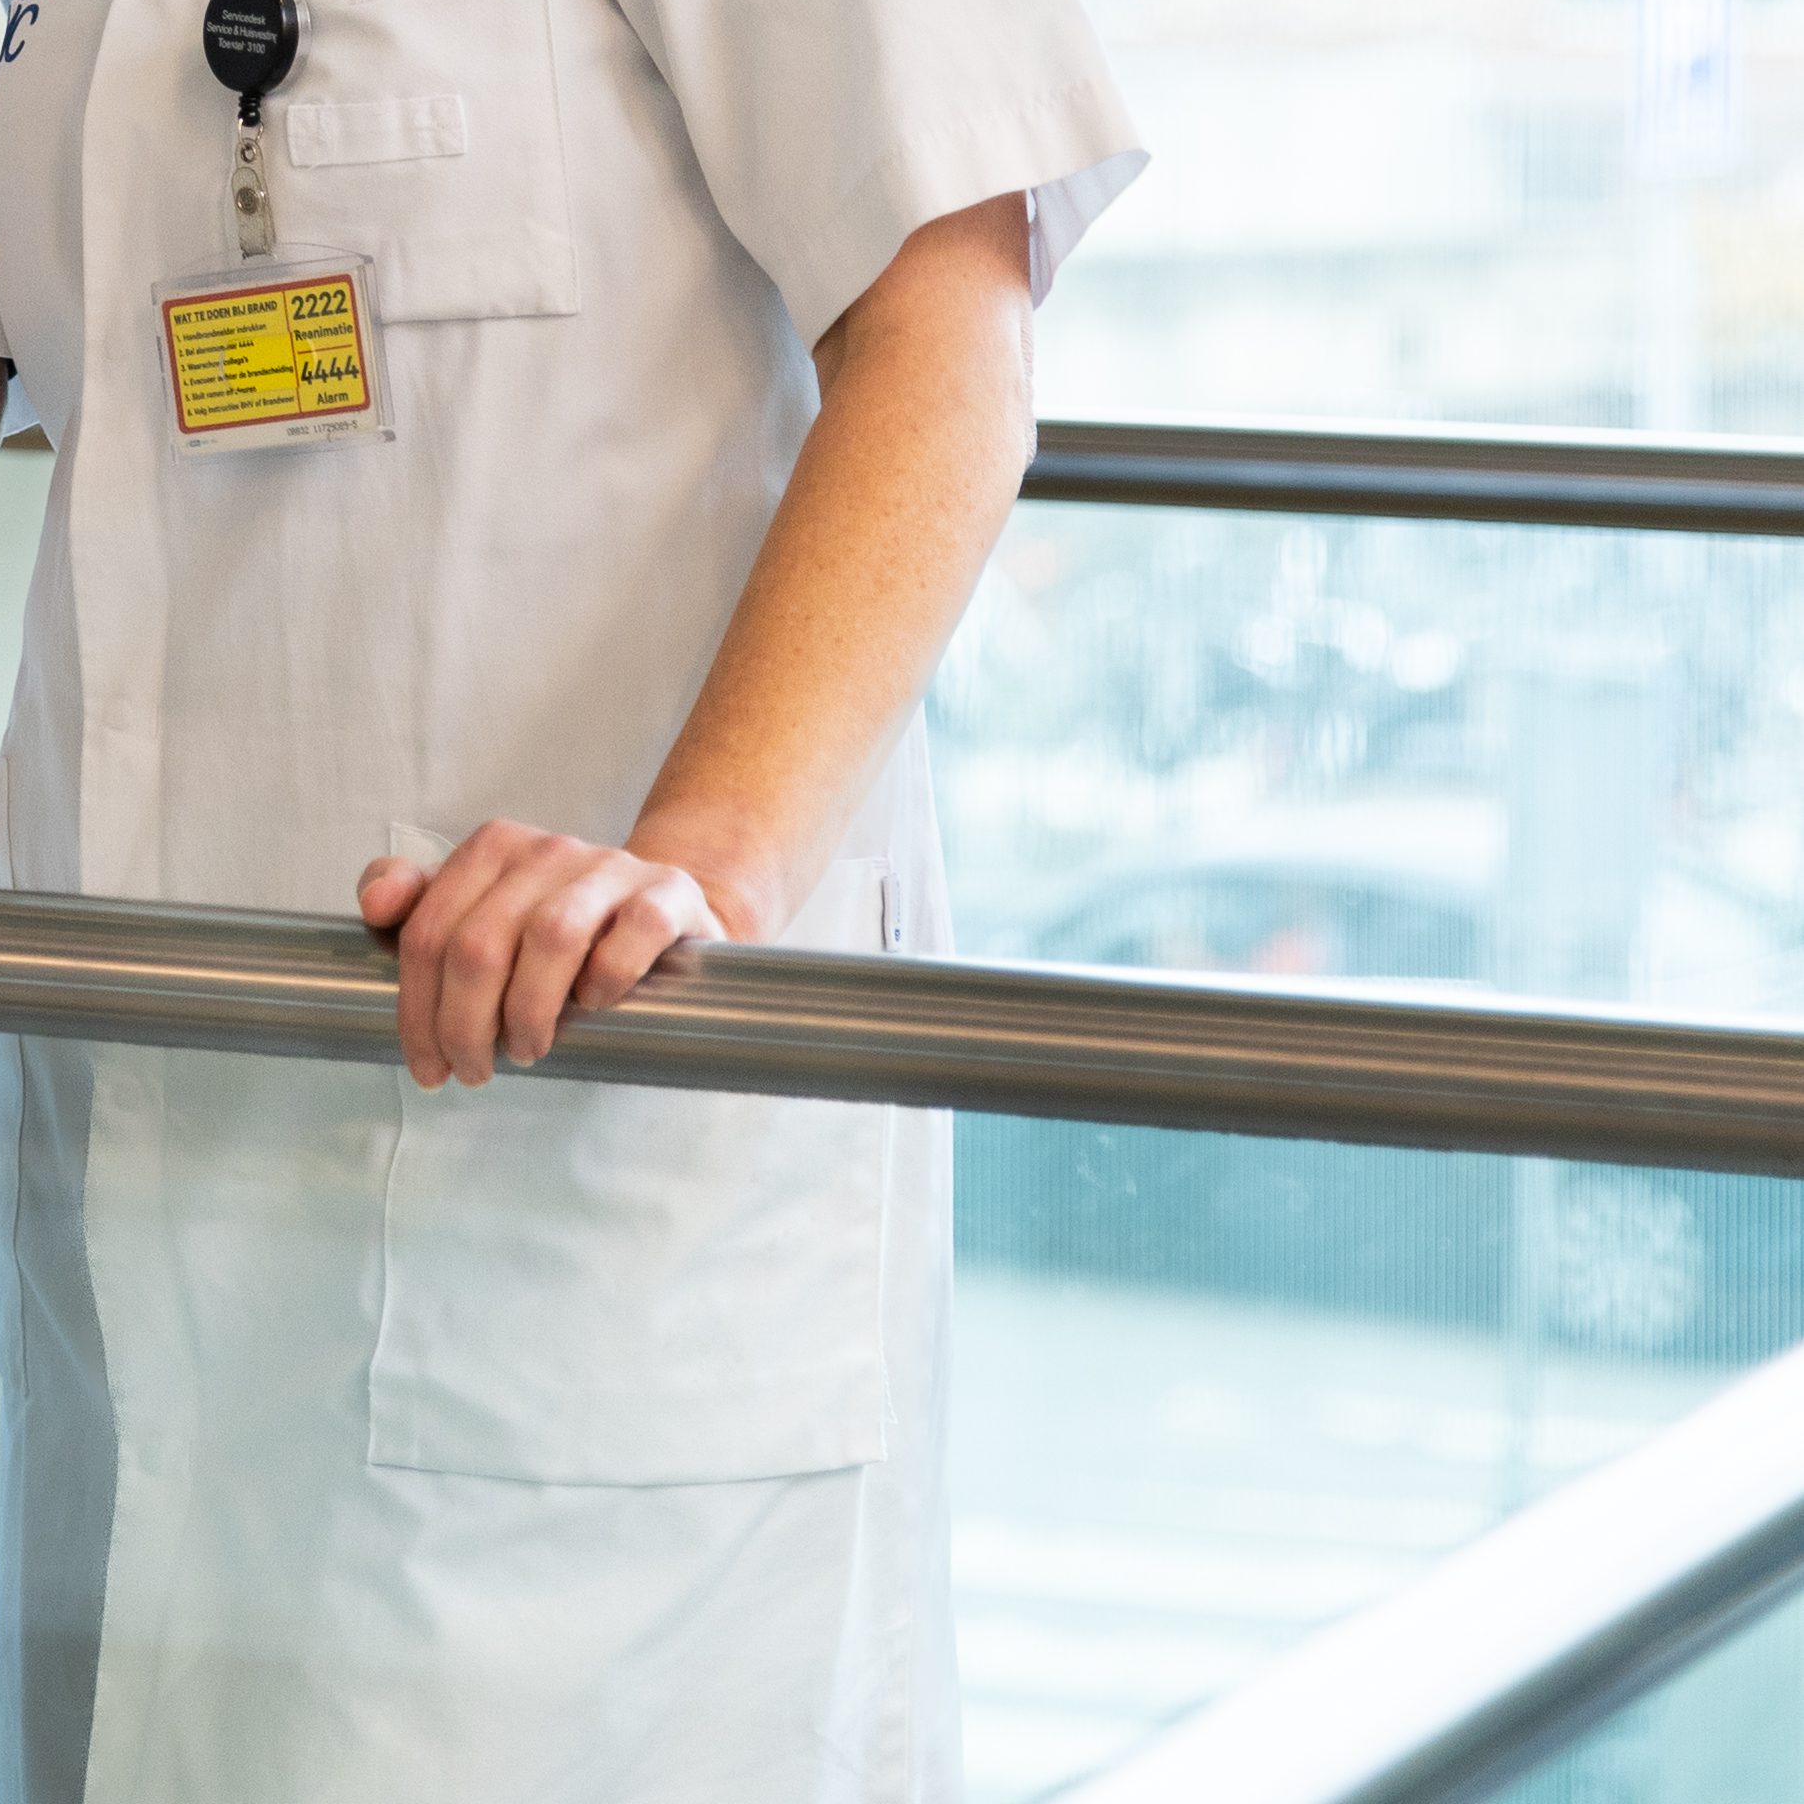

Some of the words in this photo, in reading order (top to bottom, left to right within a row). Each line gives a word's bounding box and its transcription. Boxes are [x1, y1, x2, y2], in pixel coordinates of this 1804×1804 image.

[222, 9, 266, 25] Servicedesk
[206, 21, 232, 34] Service
[233, 25, 239, 36] &
[247, 41, 266, 55] 3100
[174, 313, 192, 325] WAT
[195, 311, 205, 322] TE
[207, 307, 230, 320] DOEN
[232, 305, 246, 316] BIJ
[248, 300, 277, 314] BRAND
[291, 289, 348, 320] 2222
[294, 322, 353, 341] Reanimatie
[301, 355, 359, 385] 4444
[317, 391, 349, 405] Alarm
